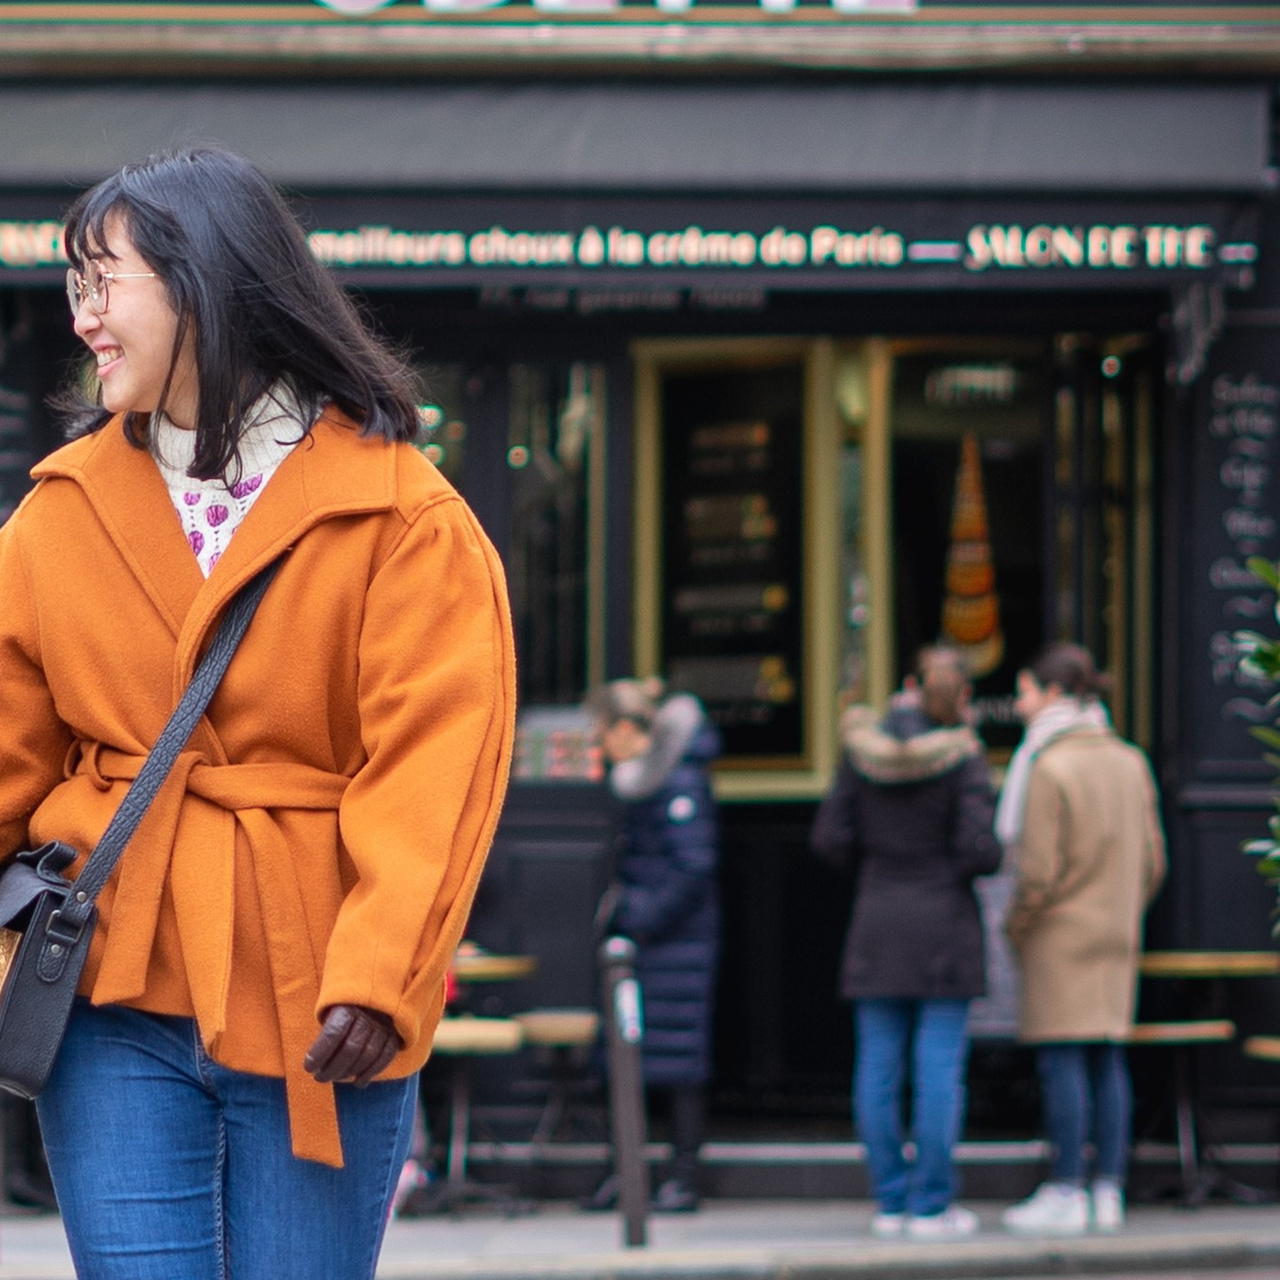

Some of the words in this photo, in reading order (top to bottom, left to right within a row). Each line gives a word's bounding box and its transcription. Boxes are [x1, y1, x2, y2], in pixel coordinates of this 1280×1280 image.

[469, 227, 574, 265] choux
[607, 227, 644, 265] la
[760, 227, 807, 265] de
[811, 226, 904, 266] Paris
[963, 225, 1084, 269] SALON
[1087, 225, 1138, 267] DE
